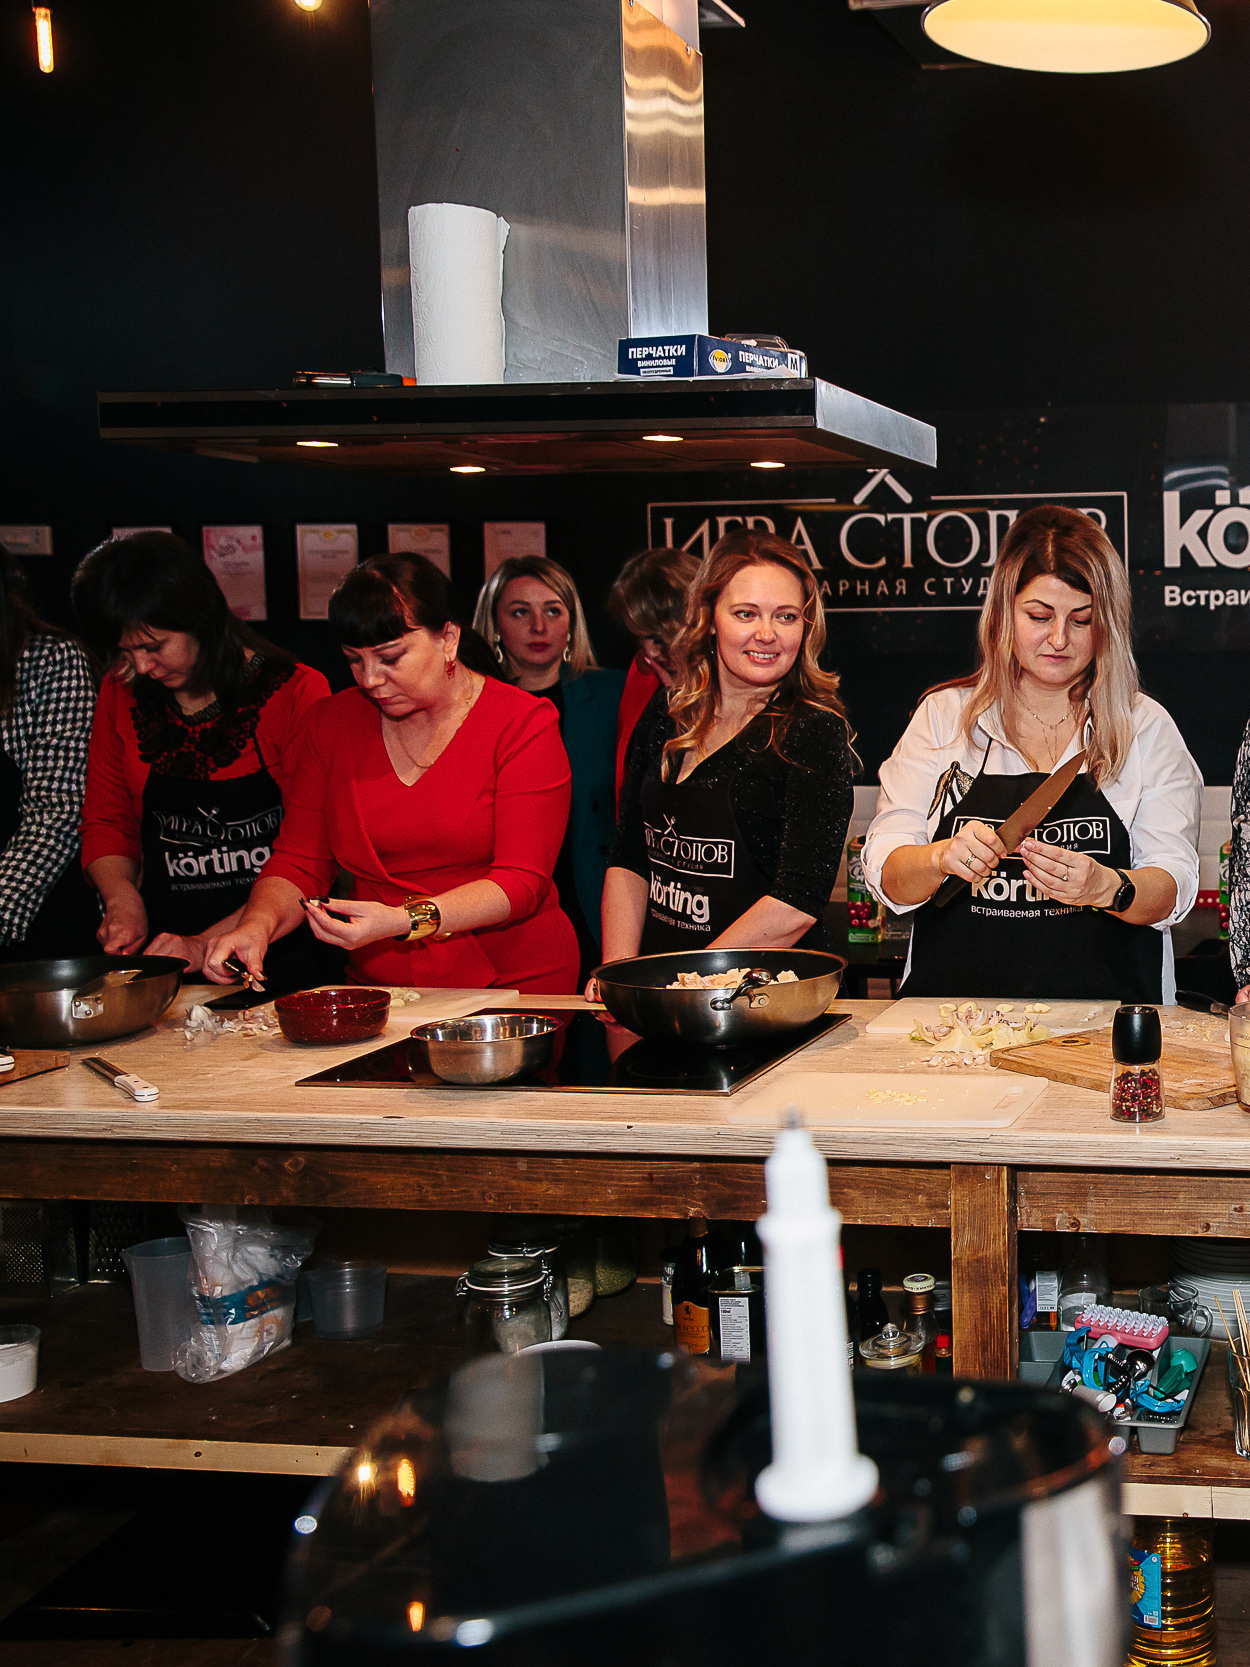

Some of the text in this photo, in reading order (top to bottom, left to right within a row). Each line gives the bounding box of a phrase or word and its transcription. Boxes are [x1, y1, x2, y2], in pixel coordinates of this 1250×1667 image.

[628, 345, 686, 359] ПЕРЧАТКИ
[738, 350, 779, 369] ПЕРЧАТКИ
[637, 358, 676, 367] ВИНИЛОВЫЕ
[1034, 821, 1105, 844] ТОЛОВ
[165, 846, 271, 877] körting
[650, 870, 710, 924] körting
[971, 904, 1041, 918] встраиваемая
[677, 920, 711, 932] техника
